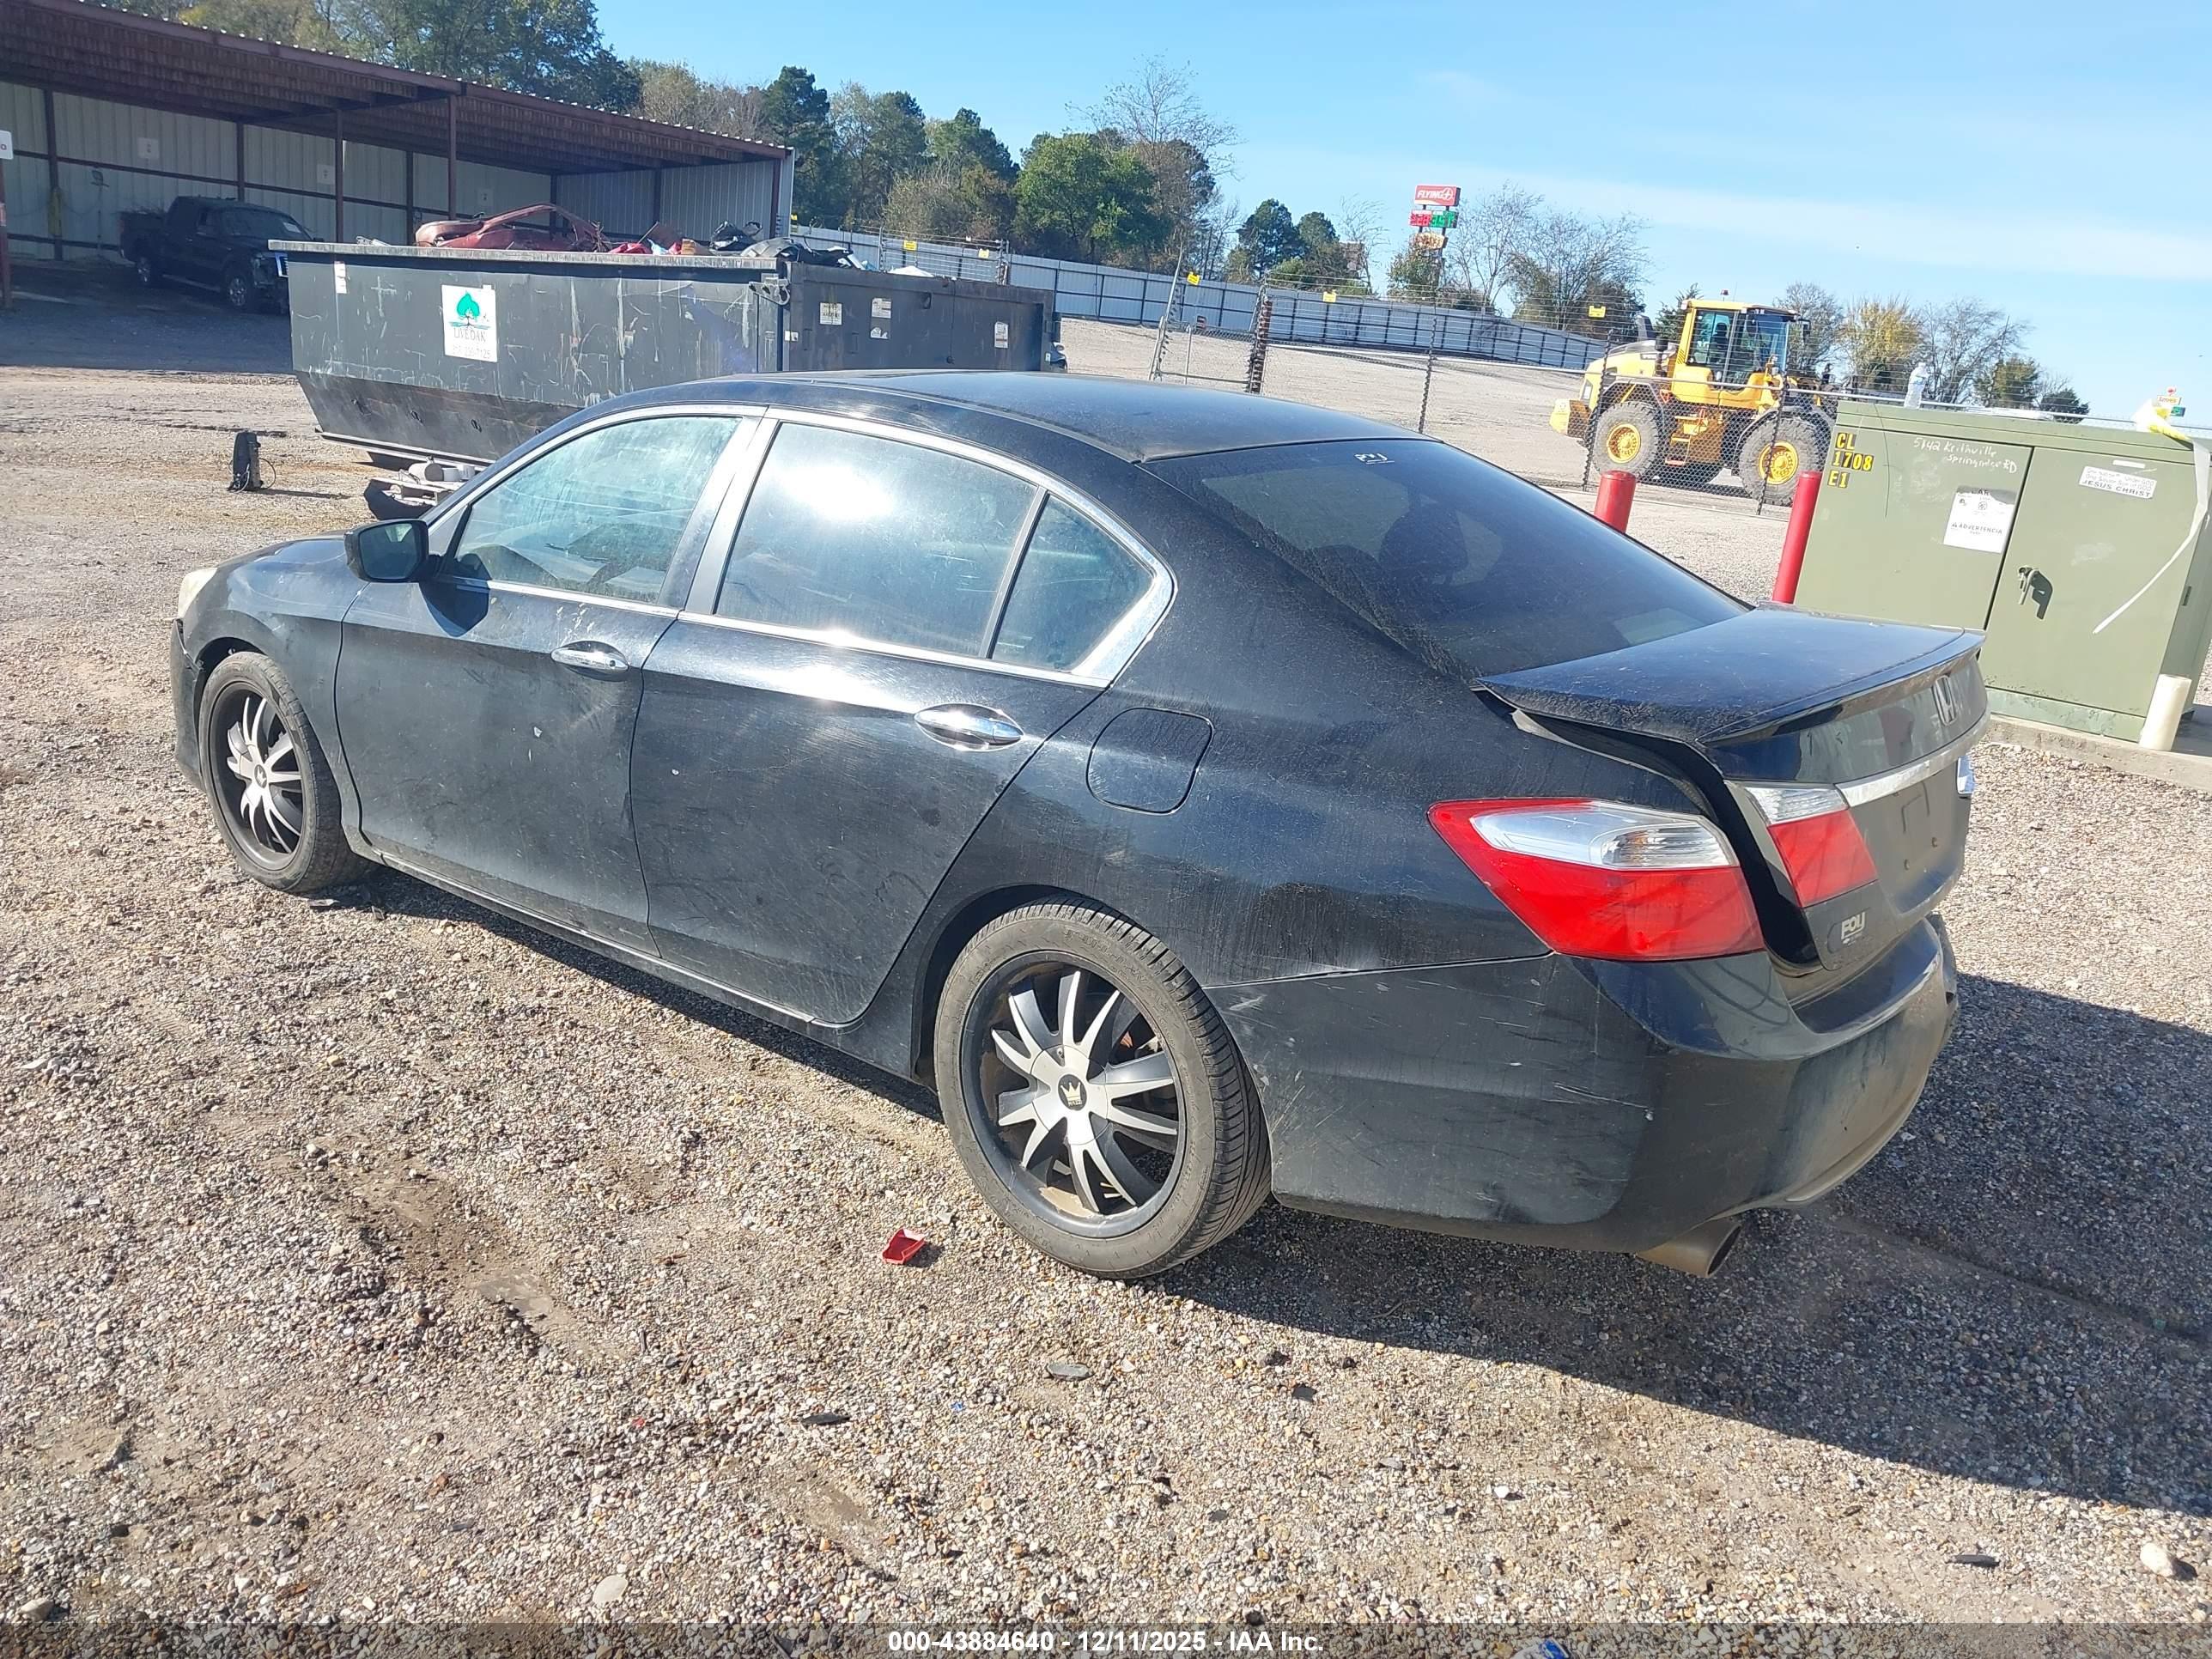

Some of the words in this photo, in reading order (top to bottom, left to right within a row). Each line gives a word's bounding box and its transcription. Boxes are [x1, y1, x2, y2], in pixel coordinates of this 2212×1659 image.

[1417, 190, 1443, 199] FLYING
[1836, 433, 1855, 450] CL
[1913, 437, 1941, 451] 5142
[1832, 452, 1873, 471] 1708
[1828, 470, 1847, 488] E1
[2082, 480, 2112, 489] JESUS
[2115, 485, 2151, 497] CHRIST
